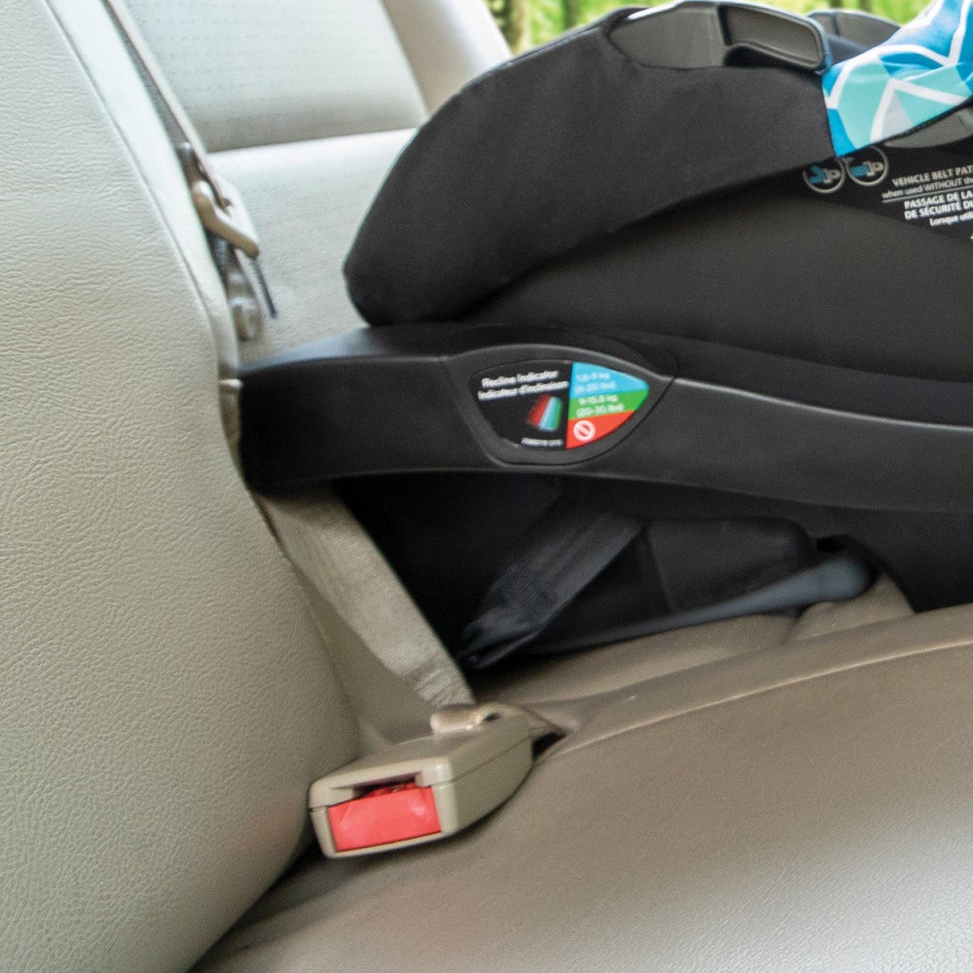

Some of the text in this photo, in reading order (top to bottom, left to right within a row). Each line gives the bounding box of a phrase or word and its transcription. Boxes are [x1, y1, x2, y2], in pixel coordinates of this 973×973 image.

[892, 172, 931, 187] VEHICLE
[931, 168, 954, 180] BELT
[882, 189, 904, 199] when
[904, 185, 923, 195] used
[924, 180, 963, 192] WITHOUT
[904, 194, 945, 209] PASSAGE
[946, 191, 959, 202] DE
[961, 189, 973, 200] LA
[904, 209, 918, 220] DE
[929, 215, 959, 227] Lorsque
